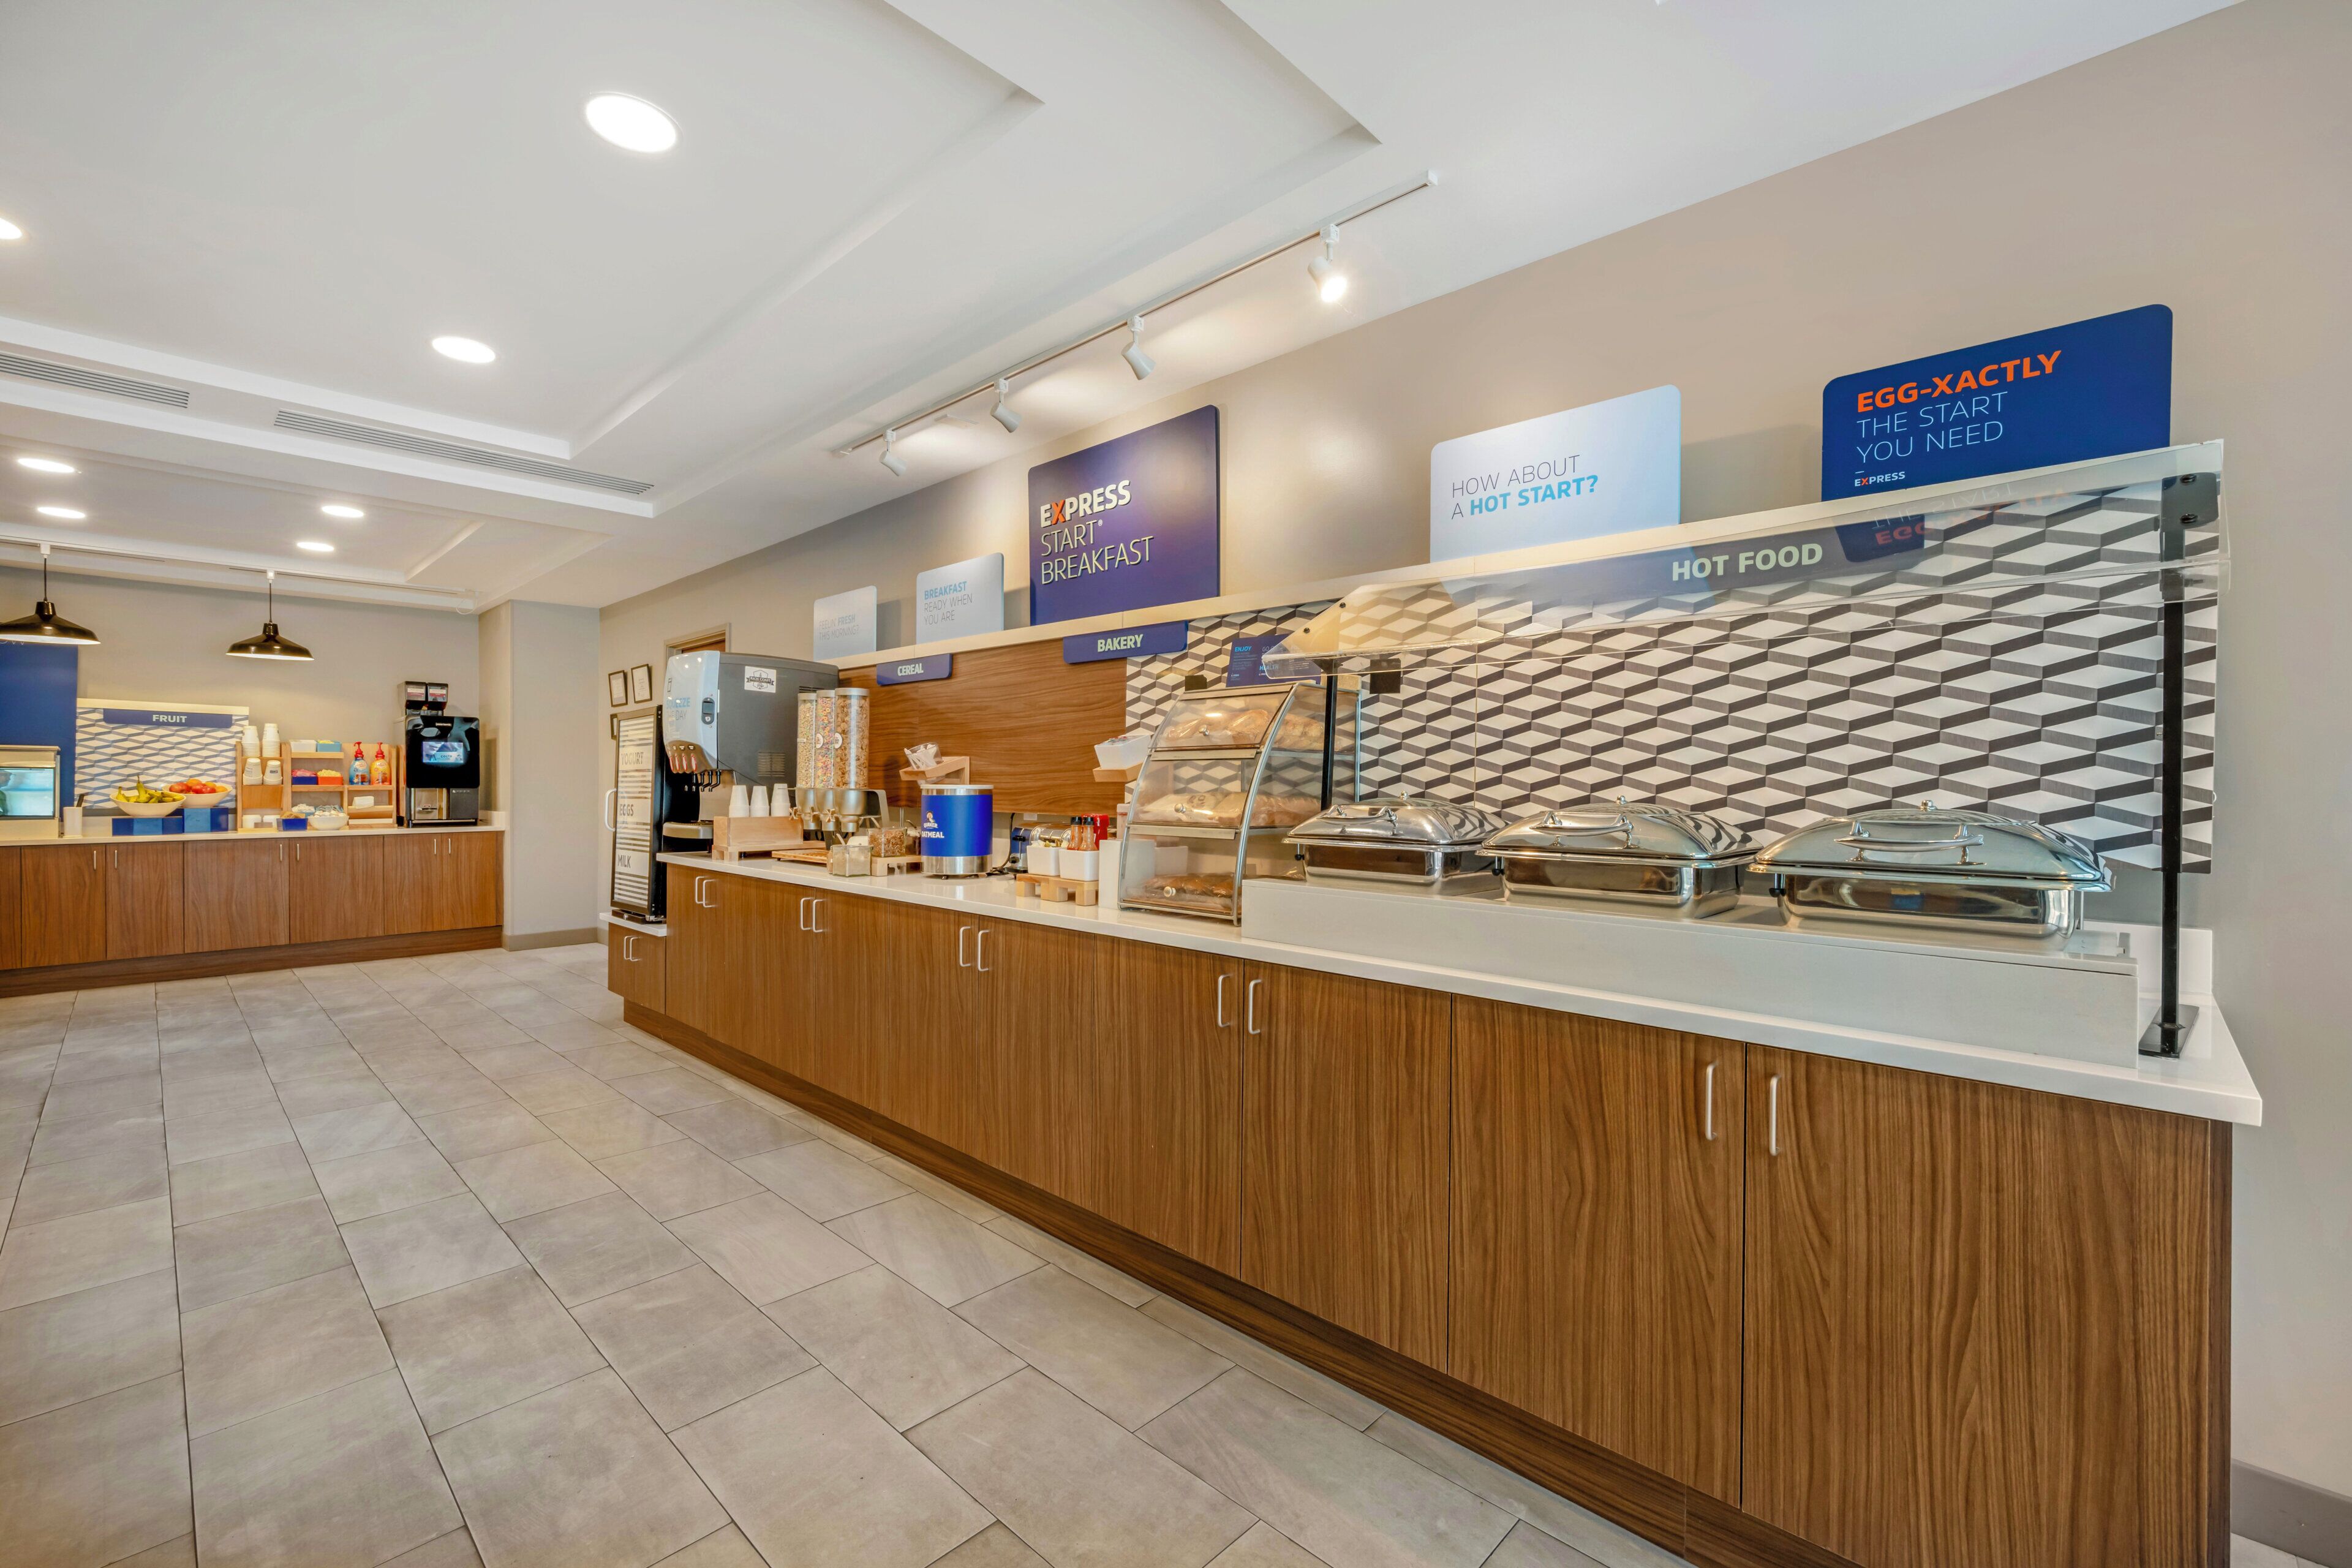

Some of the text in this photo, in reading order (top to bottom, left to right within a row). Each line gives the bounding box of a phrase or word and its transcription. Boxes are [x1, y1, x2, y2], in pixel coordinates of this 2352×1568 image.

[1858, 350, 2062, 413] EGG-XACTLY
[1856, 391, 2008, 438] THE START
[1856, 421, 2003, 463] YOU NEED
[1452, 454, 1580, 499] HOW ABOUT
[1855, 471, 1905, 487] EXPRESS
[1040, 480, 1132, 529] EXPRESS
[1451, 474, 1599, 519] A HOT START?
[1041, 535, 1155, 585] BREAKFAST
[1672, 543, 1823, 581] HOT FOOD
[924, 581, 967, 600] BREAKFAST
[924, 592, 973, 613] READY WHEN
[838, 613, 856, 626] FRESH
[923, 610, 955, 625] YOU ARE
[819, 624, 860, 642] THIS MORNING?
[1097, 634, 1144, 652] BAKERY
[897, 663, 924, 677] CEREAL
[153, 714, 187, 723] FRUIT
[676, 710, 687, 721] DAY
[621, 752, 644, 766] YOGURT
[619, 803, 634, 816] EGGS
[617, 854, 631, 869] MILK
